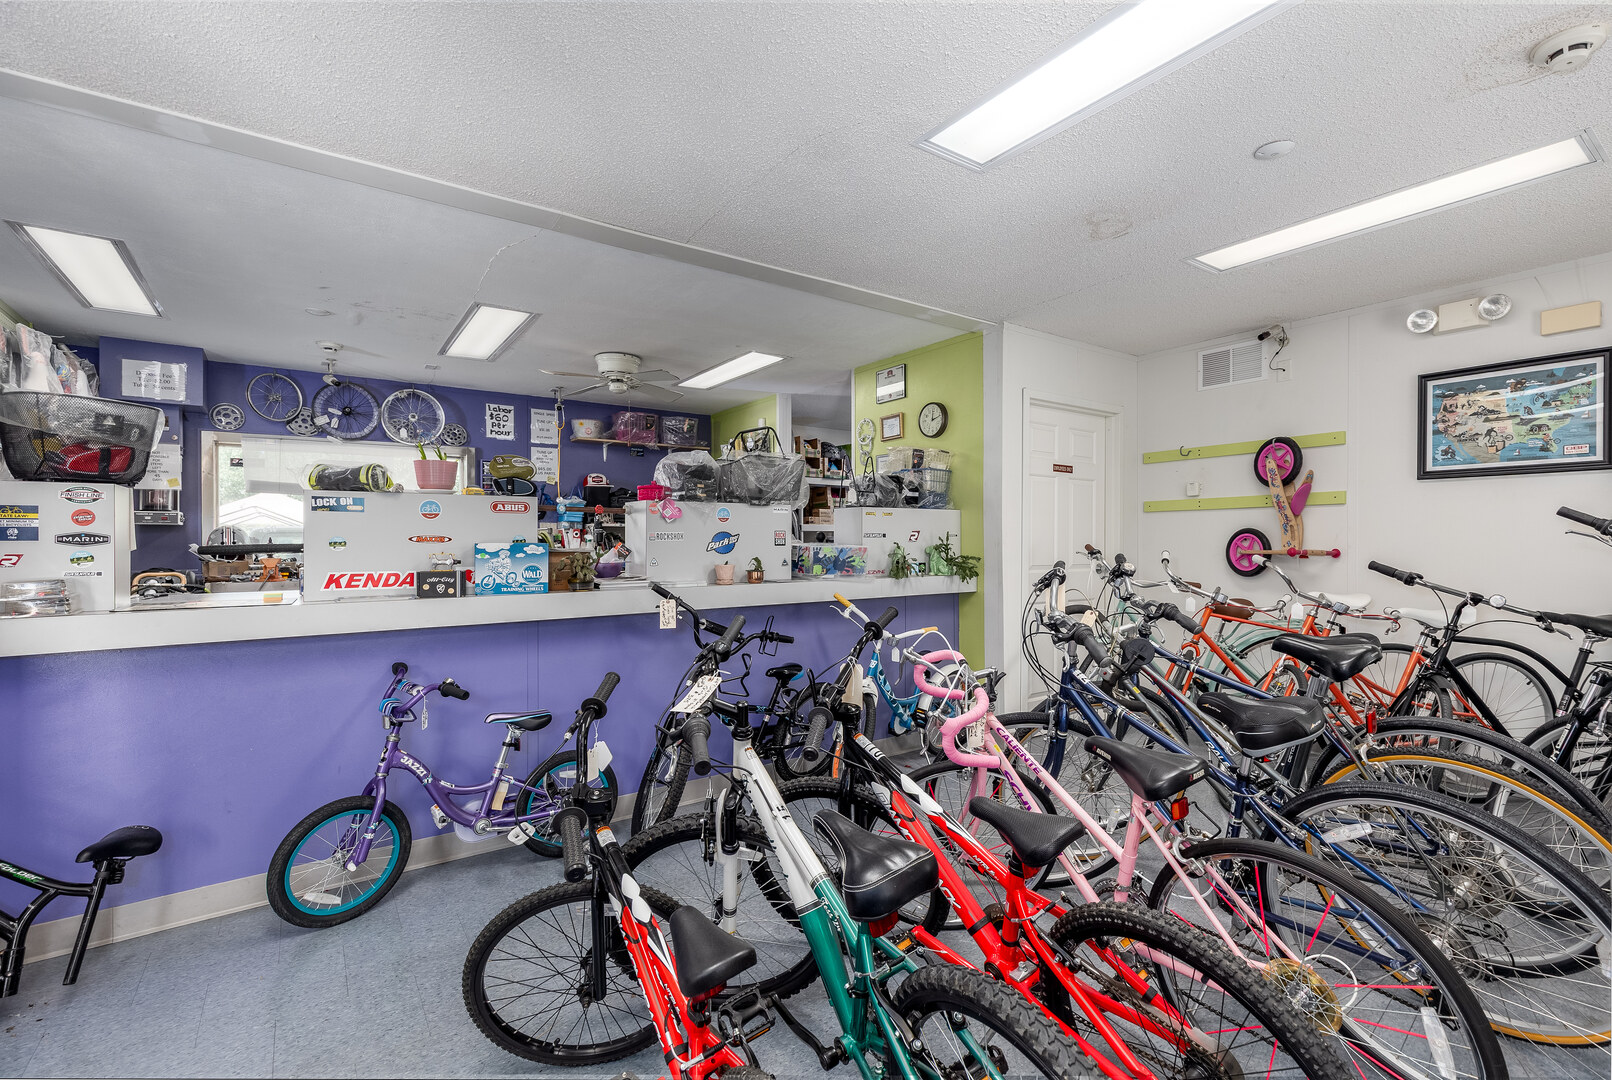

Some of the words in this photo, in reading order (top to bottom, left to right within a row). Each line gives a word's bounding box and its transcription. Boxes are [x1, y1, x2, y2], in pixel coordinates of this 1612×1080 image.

[488, 404, 513, 414] Labor
[489, 412, 509, 423] $60
[311, 497, 338, 507] LOCK
[339, 497, 354, 506] ON
[495, 504, 525, 512] ABUS
[707, 537, 729, 551] Park
[522, 570, 543, 579] WALD
[323, 572, 415, 589] KENDA
[996, 727, 1042, 775] CALIENTE
